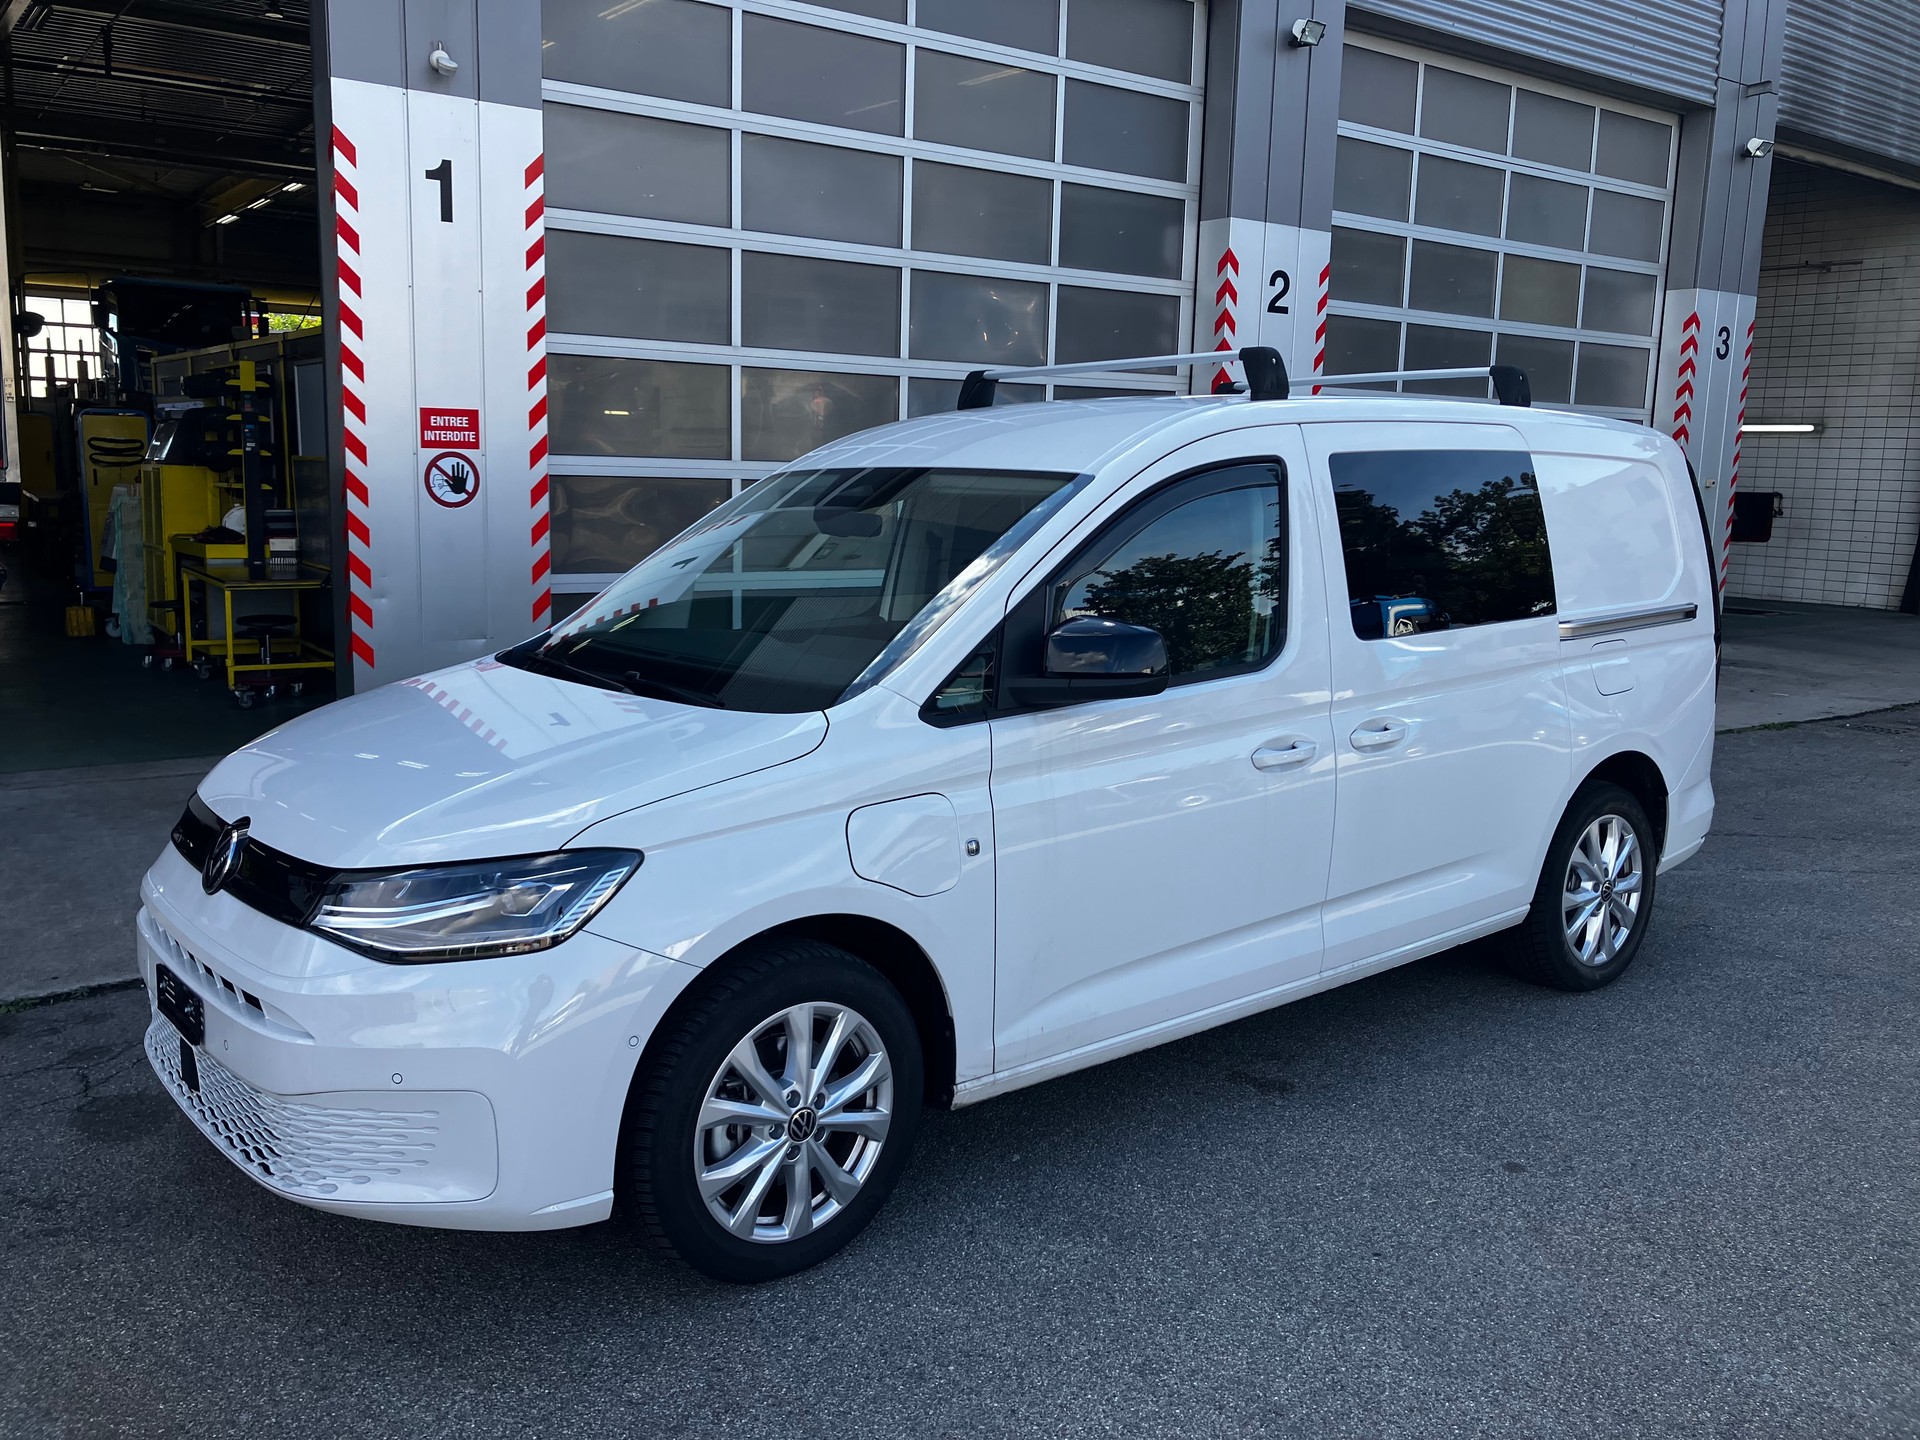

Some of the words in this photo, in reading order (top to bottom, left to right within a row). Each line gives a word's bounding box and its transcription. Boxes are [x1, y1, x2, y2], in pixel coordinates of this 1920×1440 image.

[425, 159, 453, 223] 1
[1267, 270, 1290, 314] 2
[1716, 326, 1730, 360] 3
[424, 430, 476, 442] INTERDITE
[430, 415, 469, 427] ENTREE
